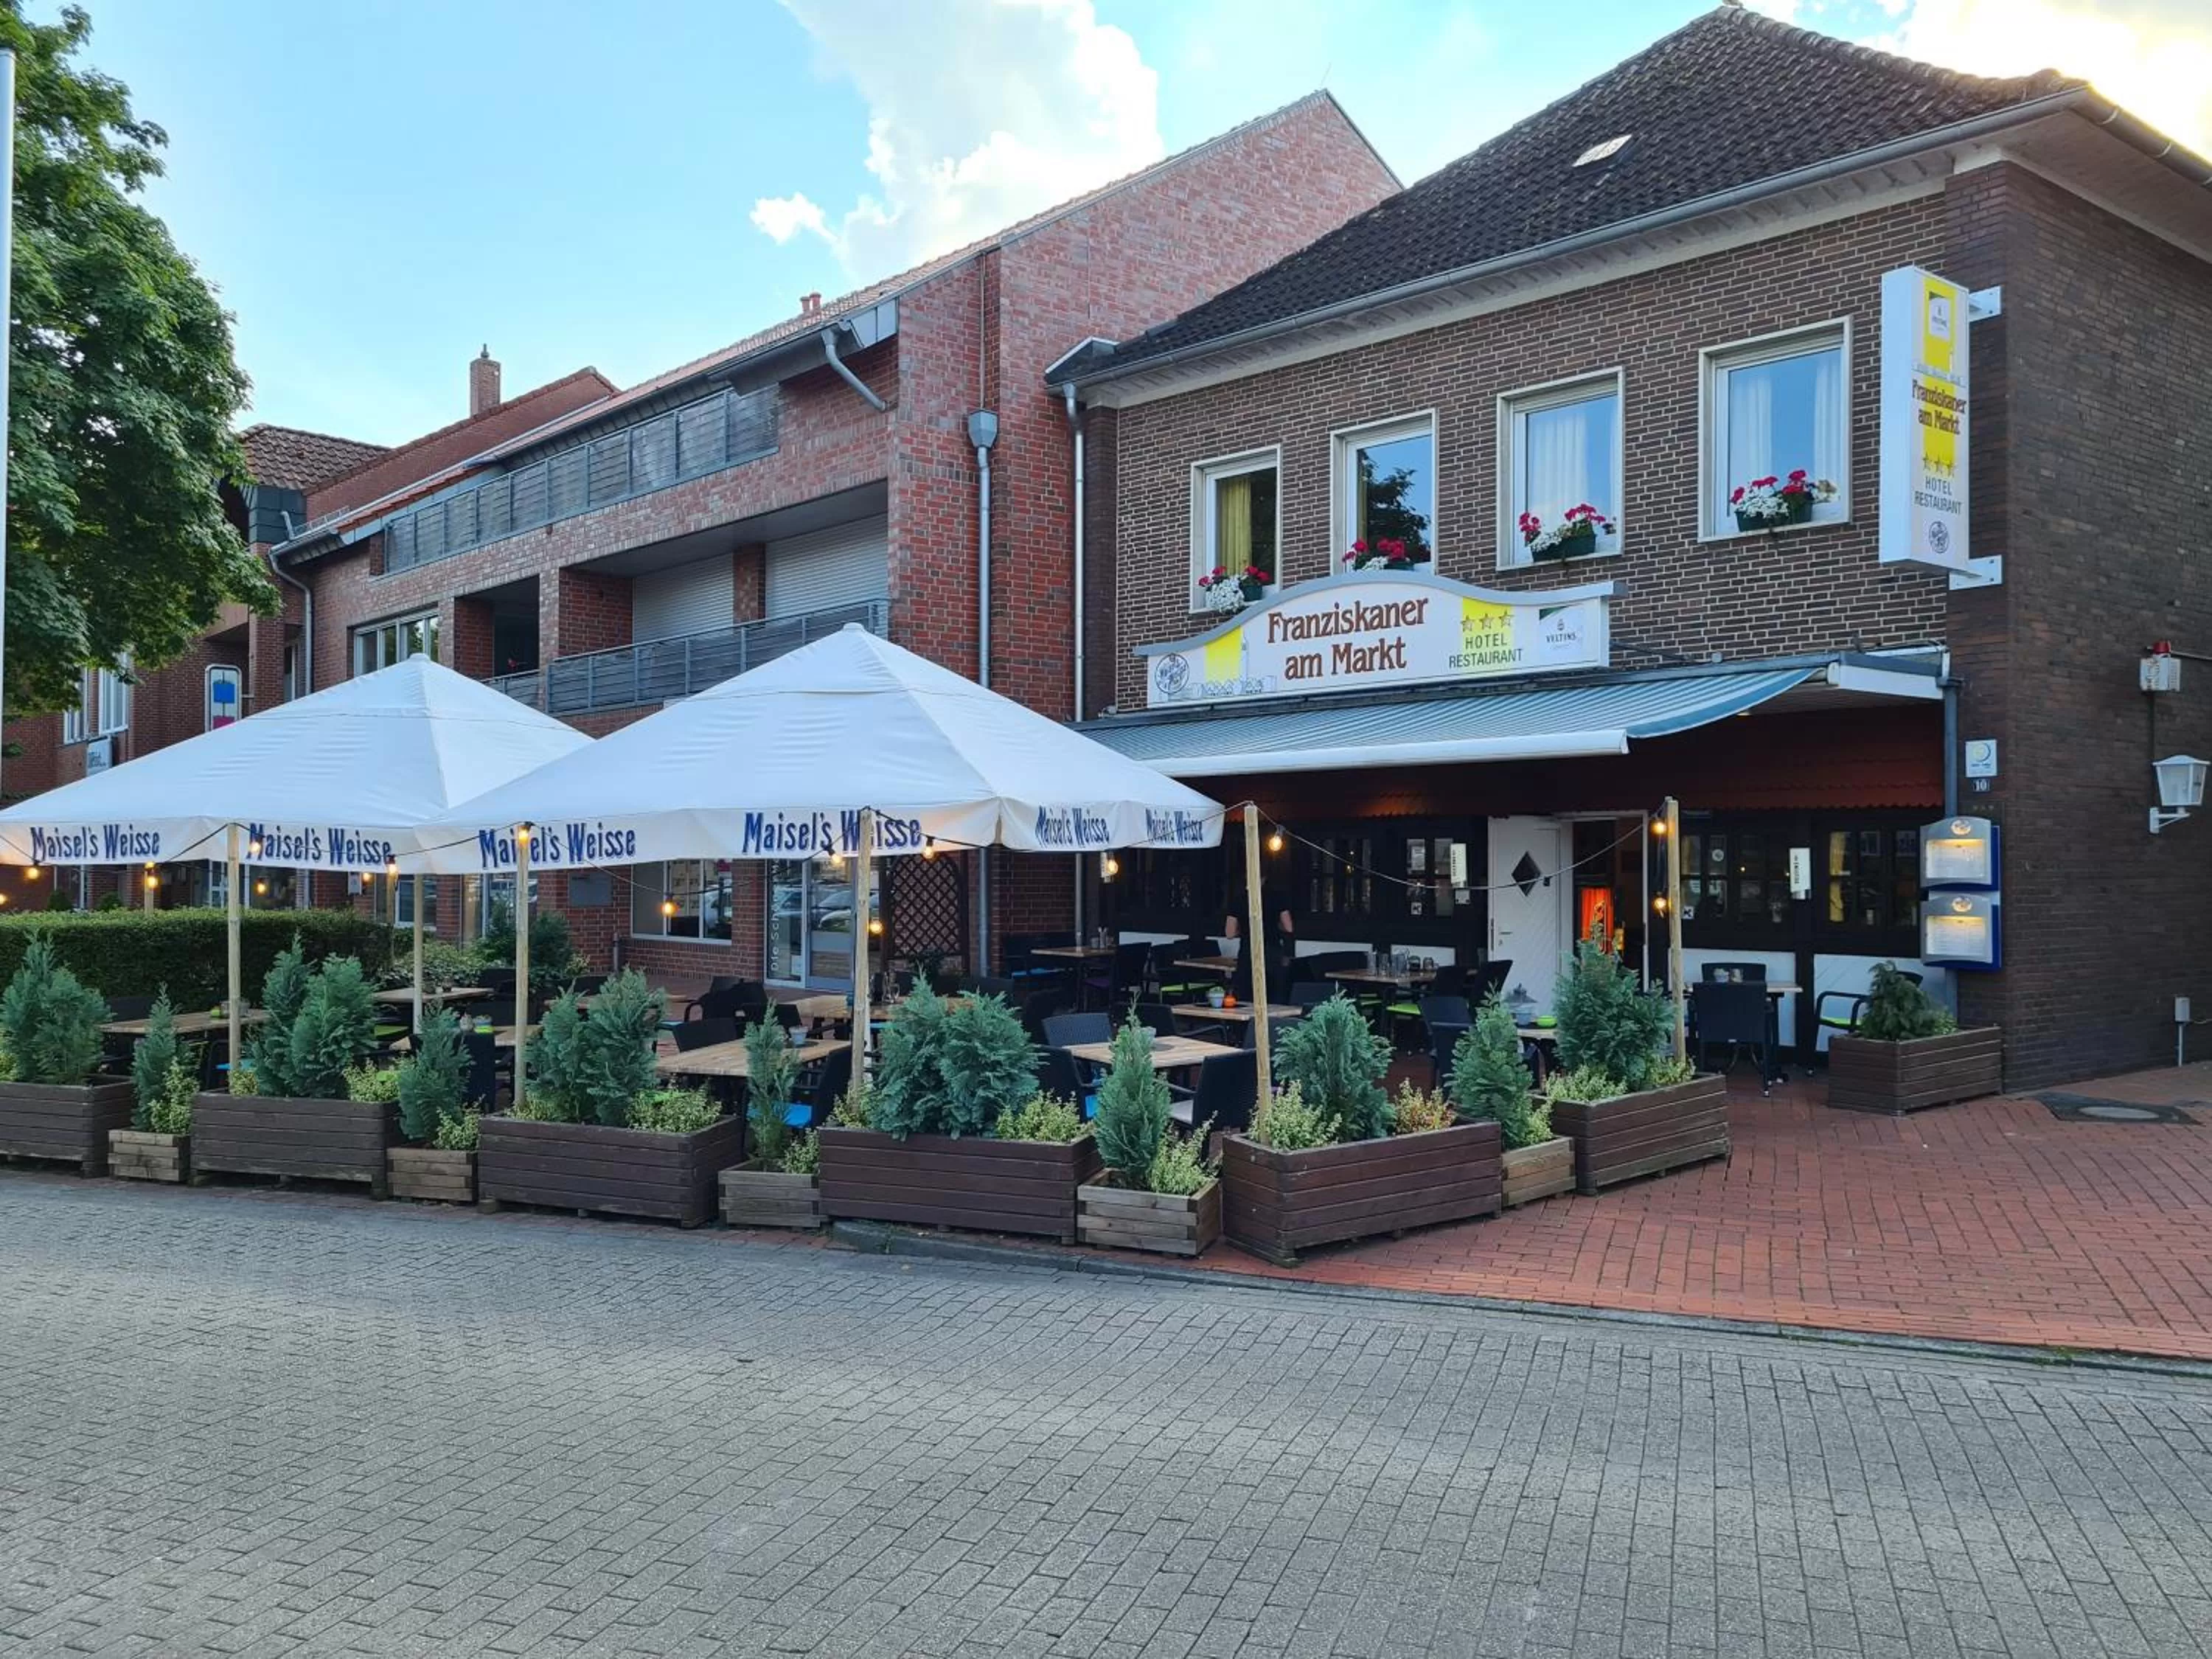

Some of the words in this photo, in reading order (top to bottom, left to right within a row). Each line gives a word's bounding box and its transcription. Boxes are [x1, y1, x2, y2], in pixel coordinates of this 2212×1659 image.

[1912, 379, 1966, 414] Franziskaner
[1918, 410, 1933, 427] am
[1934, 410, 1960, 435] Markt
[1915, 491, 1961, 515] RESTAURANT
[1925, 476, 1952, 495] HOTEL
[1267, 597, 1429, 644] Franziskaner
[1284, 650, 1328, 681] am
[1331, 636, 1408, 674] Markt
[1448, 648, 1523, 668] RESTAURANT
[1464, 634, 1509, 650] HOTEL
[30, 825, 99, 861] Maisel's
[104, 824, 160, 859] Weisse
[478, 827, 561, 869] Maiel's
[566, 821, 636, 862] Weisse
[742, 812, 831, 855] Maisel's
[841, 810, 921, 852] Wisse
[1035, 805, 1073, 847] Maisel's
[1073, 807, 1110, 848] Weisse
[327, 827, 392, 866] Weisse
